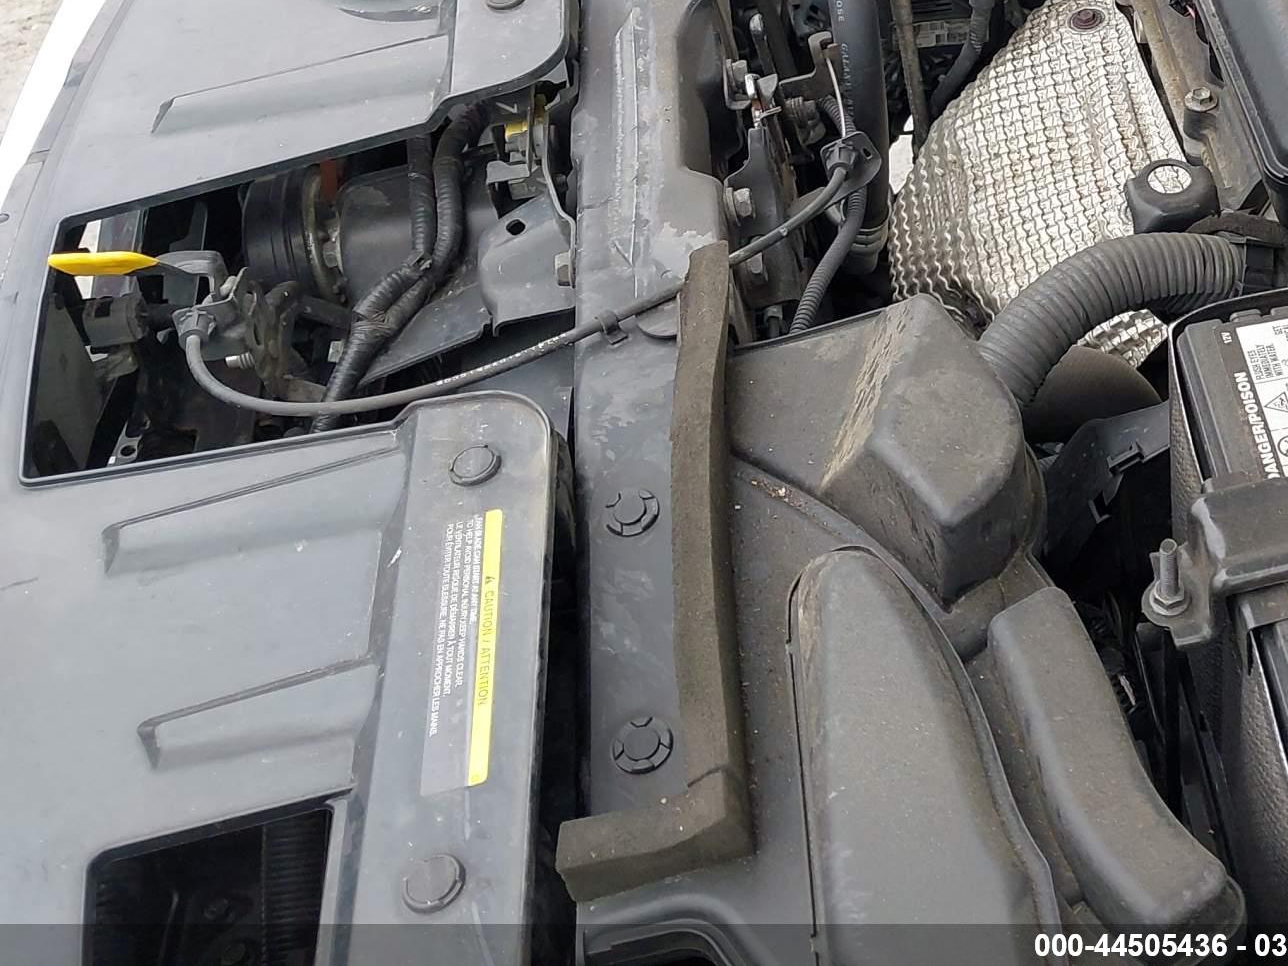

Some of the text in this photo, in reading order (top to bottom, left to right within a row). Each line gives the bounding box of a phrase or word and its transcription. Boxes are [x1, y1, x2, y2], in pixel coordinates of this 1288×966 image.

[1221, 331, 1232, 343] 12V
[1273, 325, 1283, 335] GET
[1246, 349, 1258, 364] EYES
[1255, 344, 1274, 378] IMMEDIATELY
[1270, 359, 1283, 375] WITH
[482, 590, 494, 636] CAUTION
[445, 646, 453, 662] TOUT
[456, 638, 465, 661] HANDS
[477, 647, 490, 705] ATTENTION
